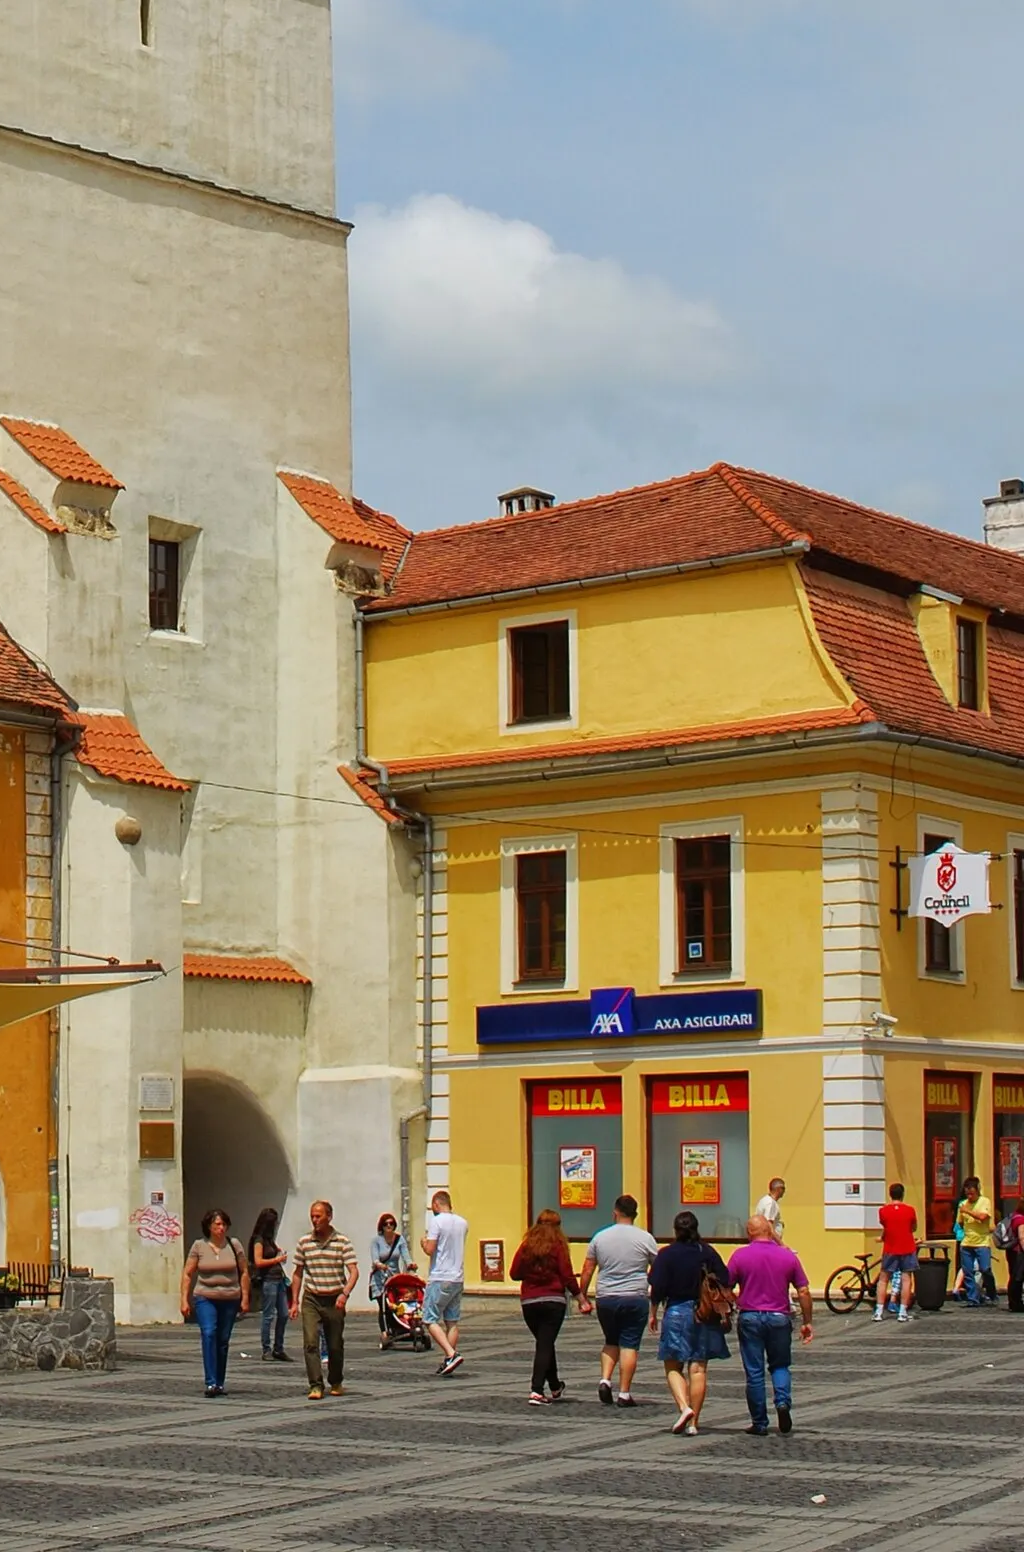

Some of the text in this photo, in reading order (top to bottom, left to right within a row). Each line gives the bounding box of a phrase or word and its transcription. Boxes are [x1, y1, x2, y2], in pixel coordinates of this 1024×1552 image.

[924, 896, 970, 909] Council
[591, 1013, 623, 1034] AXA
[654, 1014, 753, 1030] AXA ASIGURARI
[548, 1088, 606, 1111] BILLA
[669, 1084, 730, 1108] BILLA
[928, 1083, 960, 1106] BILLA
[995, 1086, 1024, 1108] BILLA
